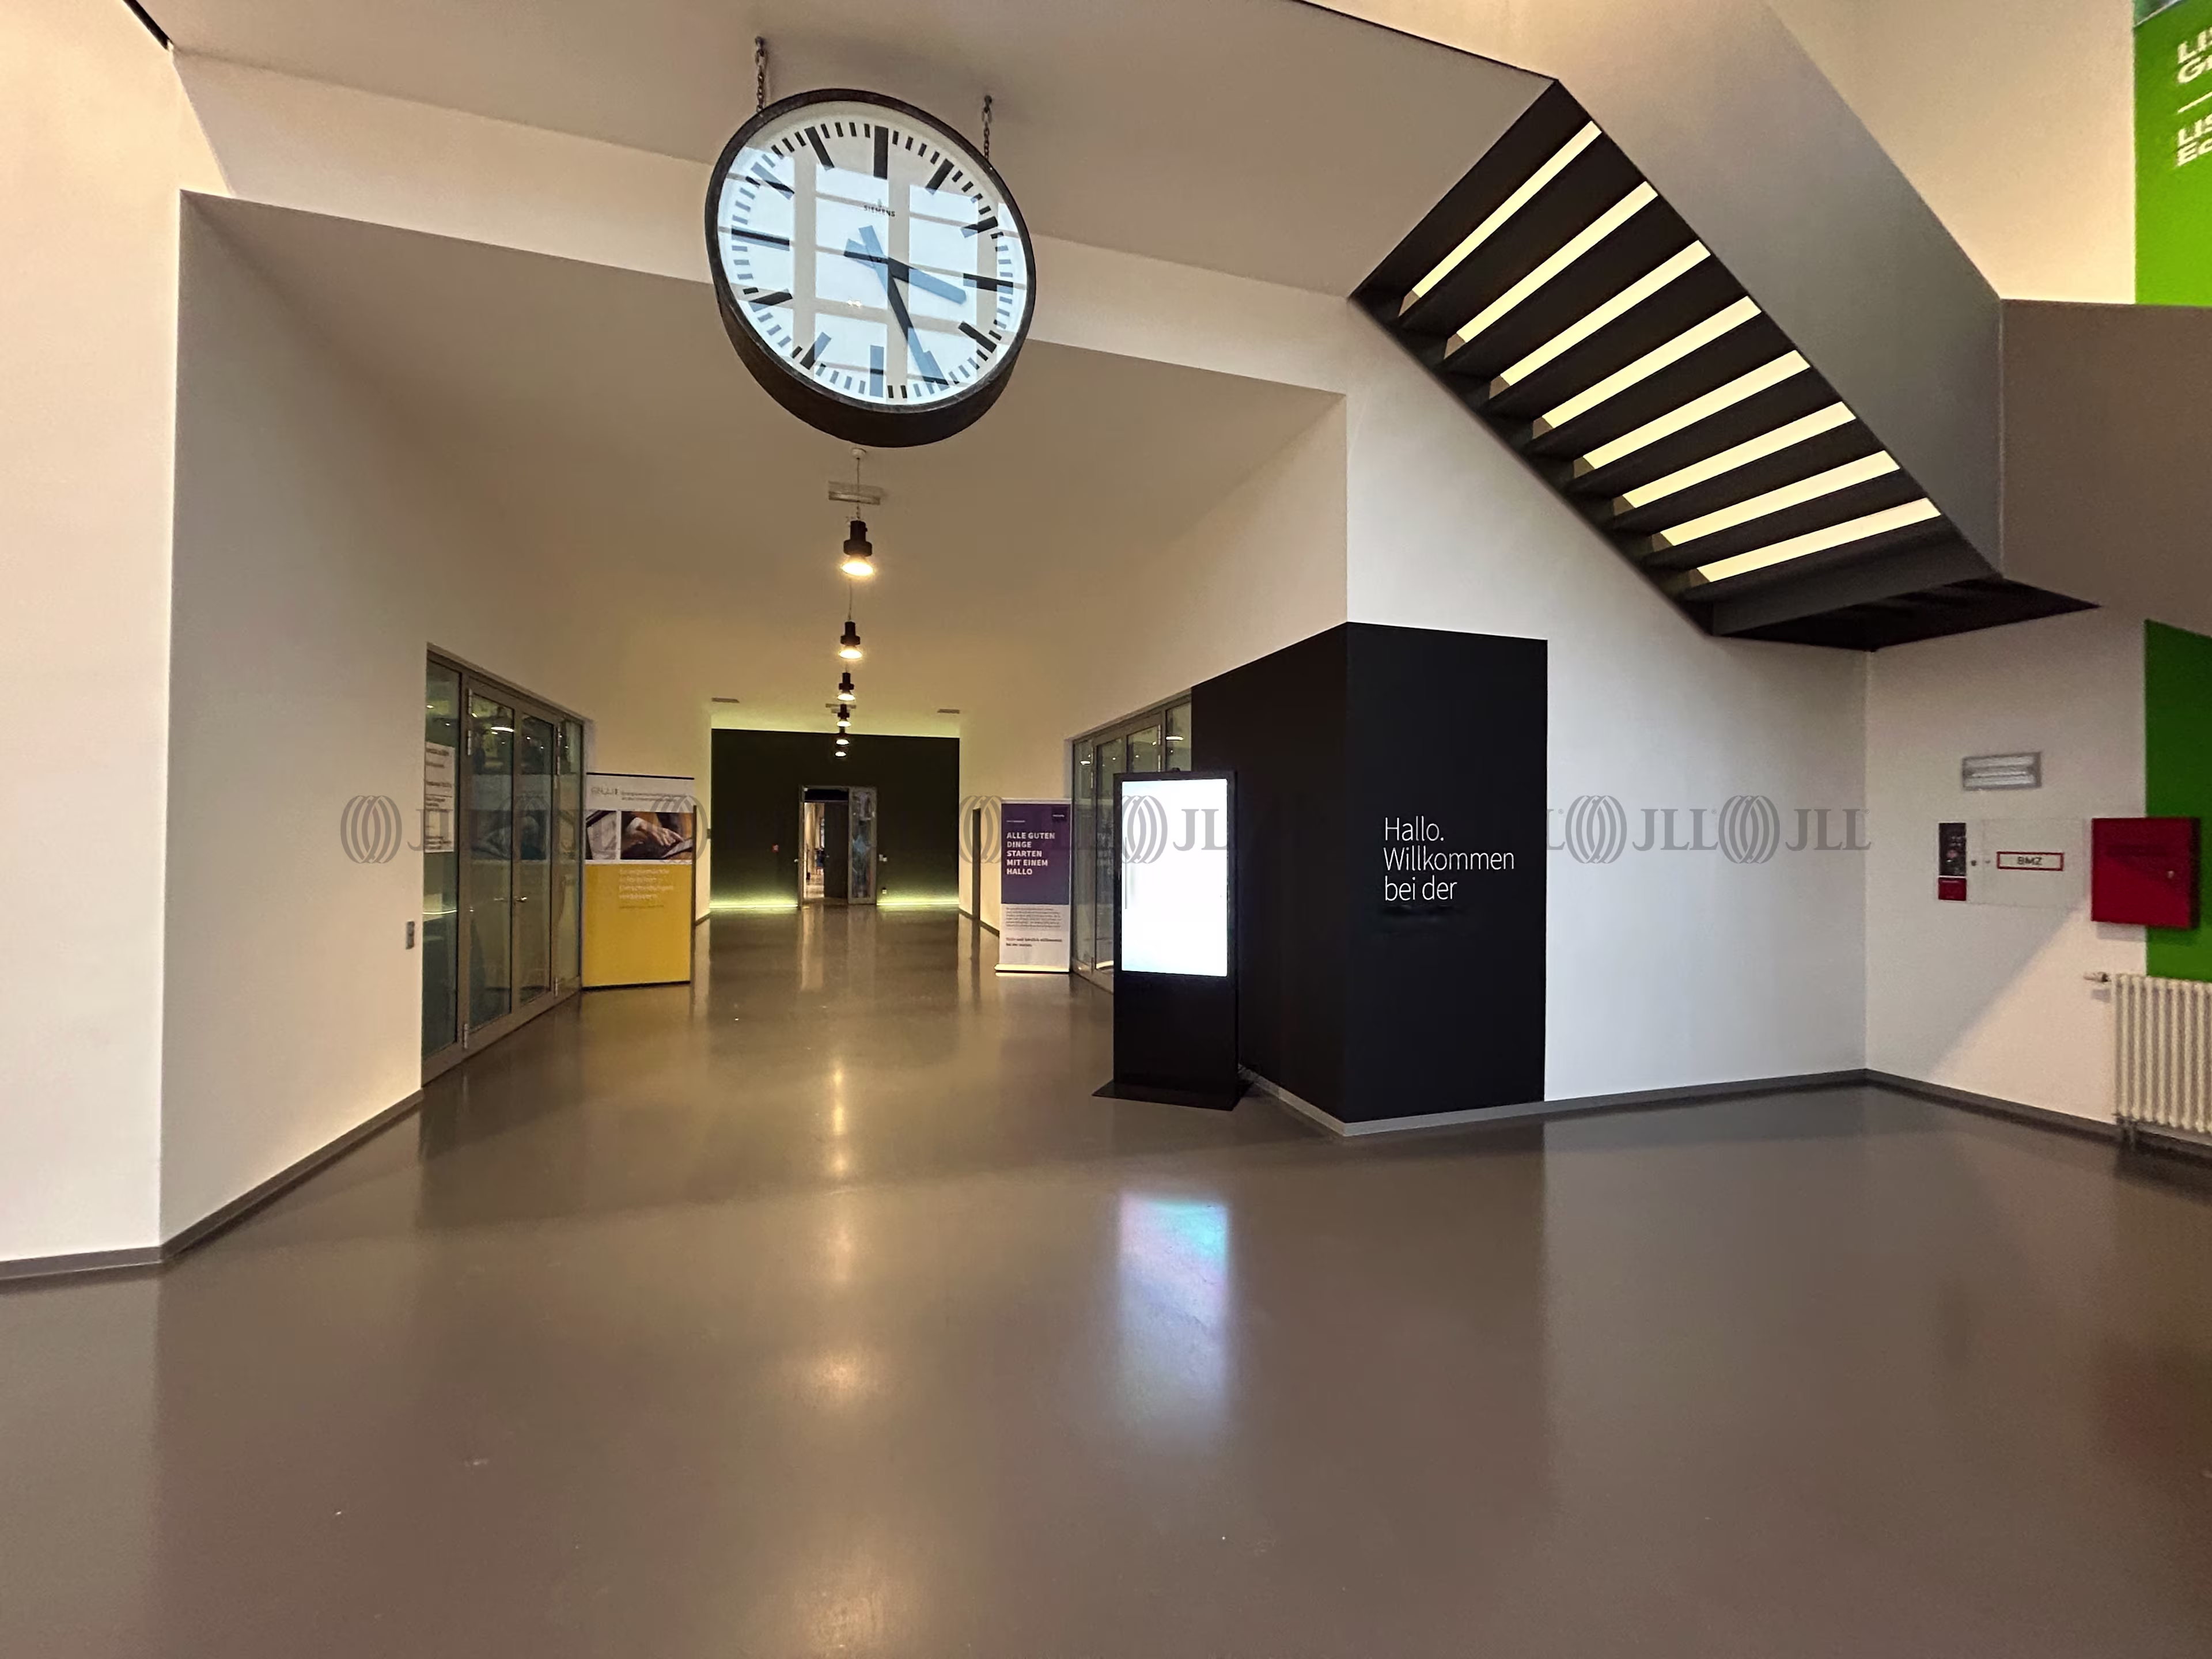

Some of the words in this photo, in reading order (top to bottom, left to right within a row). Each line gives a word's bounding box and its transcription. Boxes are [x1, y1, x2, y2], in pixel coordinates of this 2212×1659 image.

[1385, 816, 1444, 841] Hallo.
[1383, 845, 1514, 871] Willkommen
[2017, 857, 2042, 865] BMZ
[1385, 875, 1416, 901] bei
[1422, 874, 1457, 901] der
